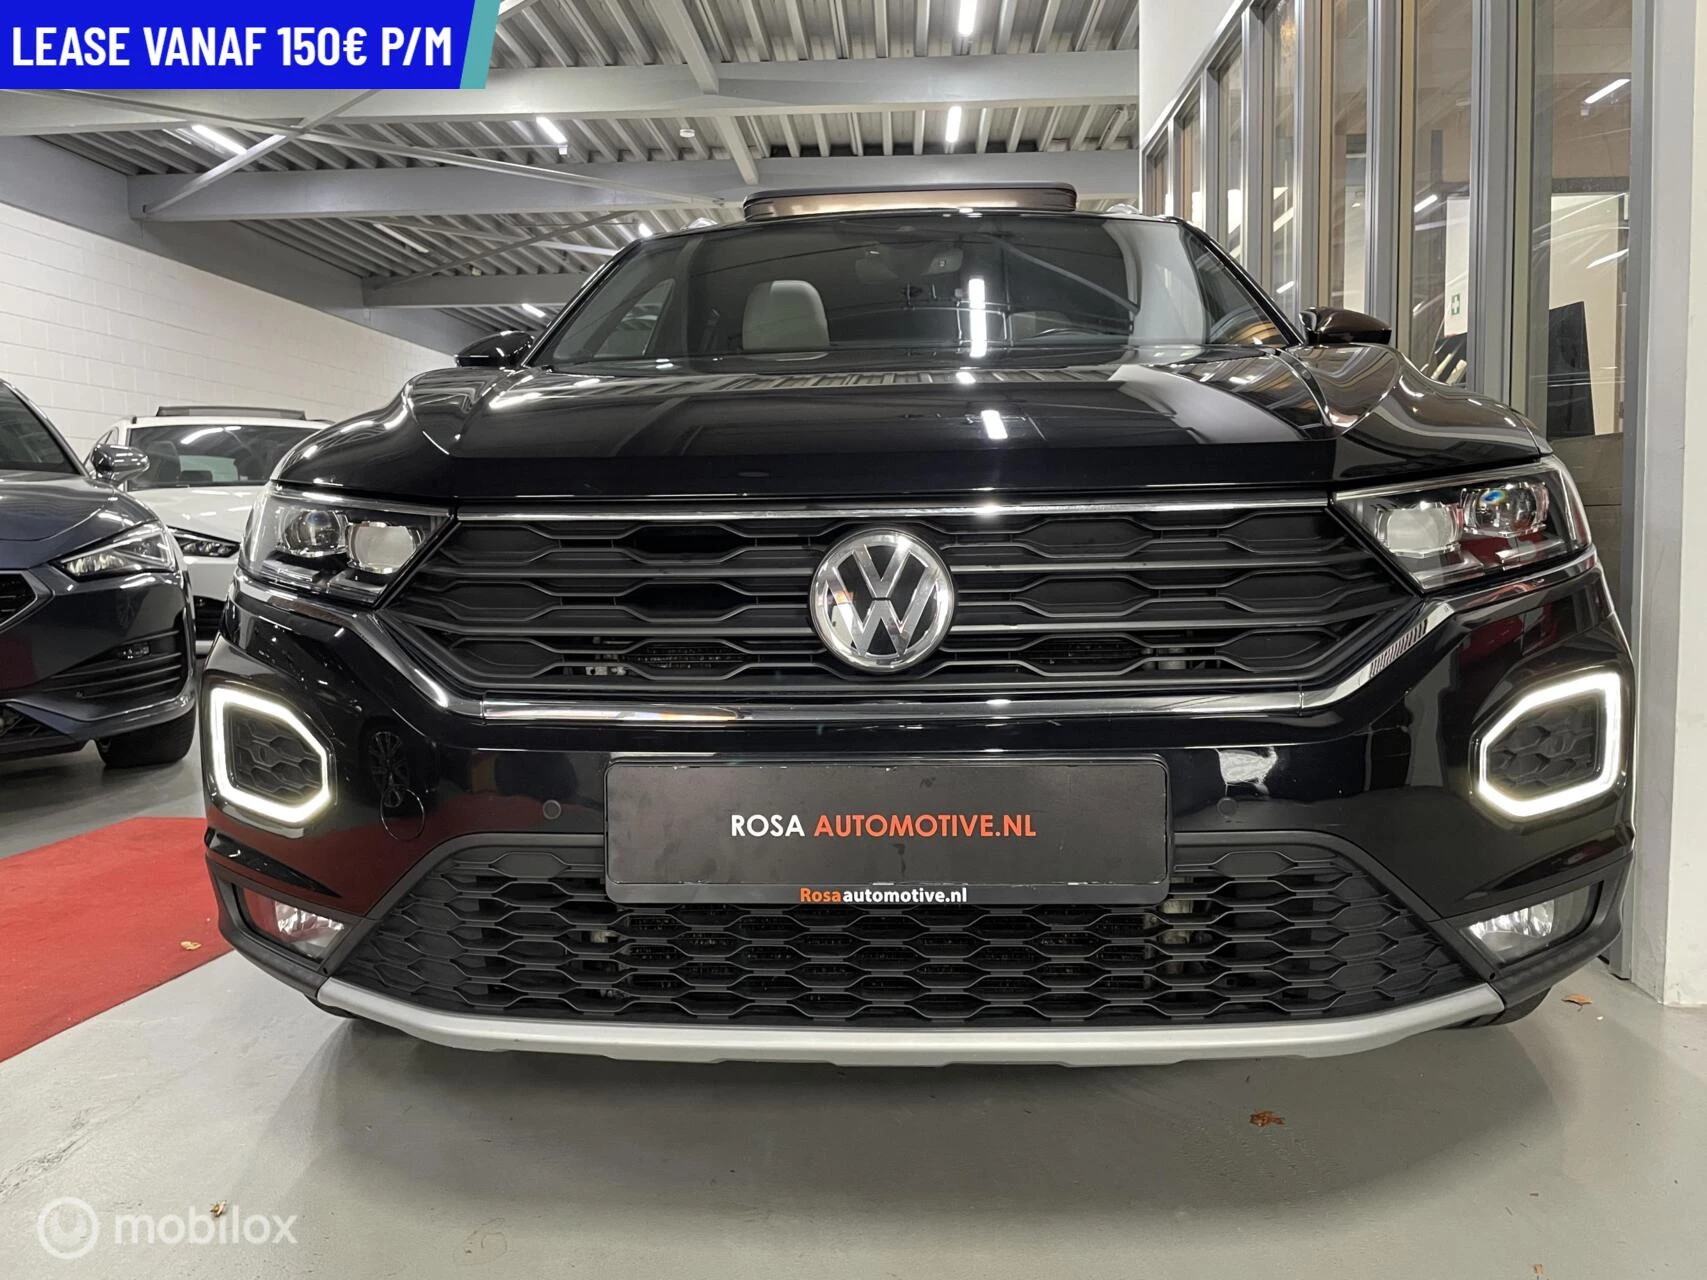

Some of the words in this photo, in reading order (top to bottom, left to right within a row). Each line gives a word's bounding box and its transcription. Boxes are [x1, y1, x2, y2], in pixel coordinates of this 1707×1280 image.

[815, 536, 945, 659] VW
[730, 814, 806, 838] ROSA
[813, 814, 1037, 838] AUTOMOTIVE.NL
